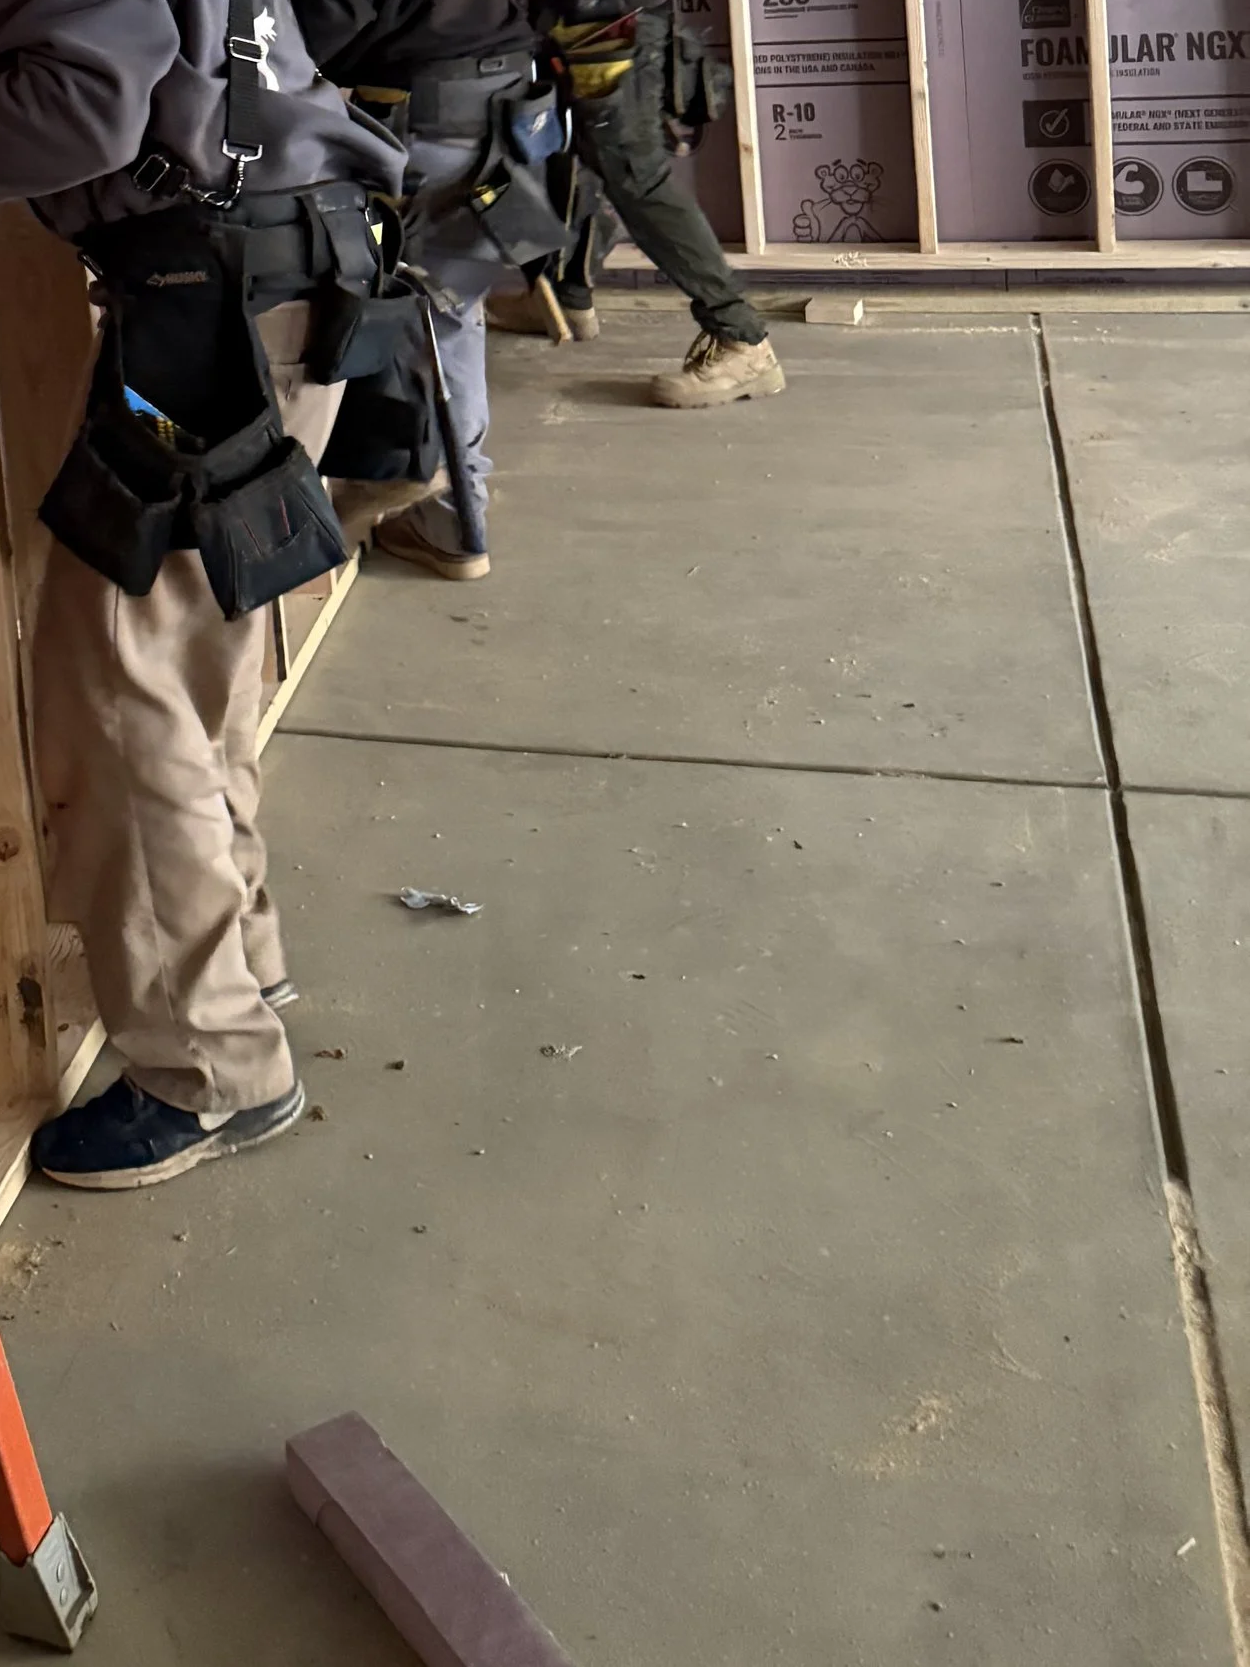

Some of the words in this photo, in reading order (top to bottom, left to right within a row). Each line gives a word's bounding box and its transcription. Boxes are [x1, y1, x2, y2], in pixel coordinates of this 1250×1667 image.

[1186, 30, 1249, 62] NGX
[772, 102, 816, 123] R-10
[774, 123, 787, 141] 2
[1152, 121, 1172, 131] AND
